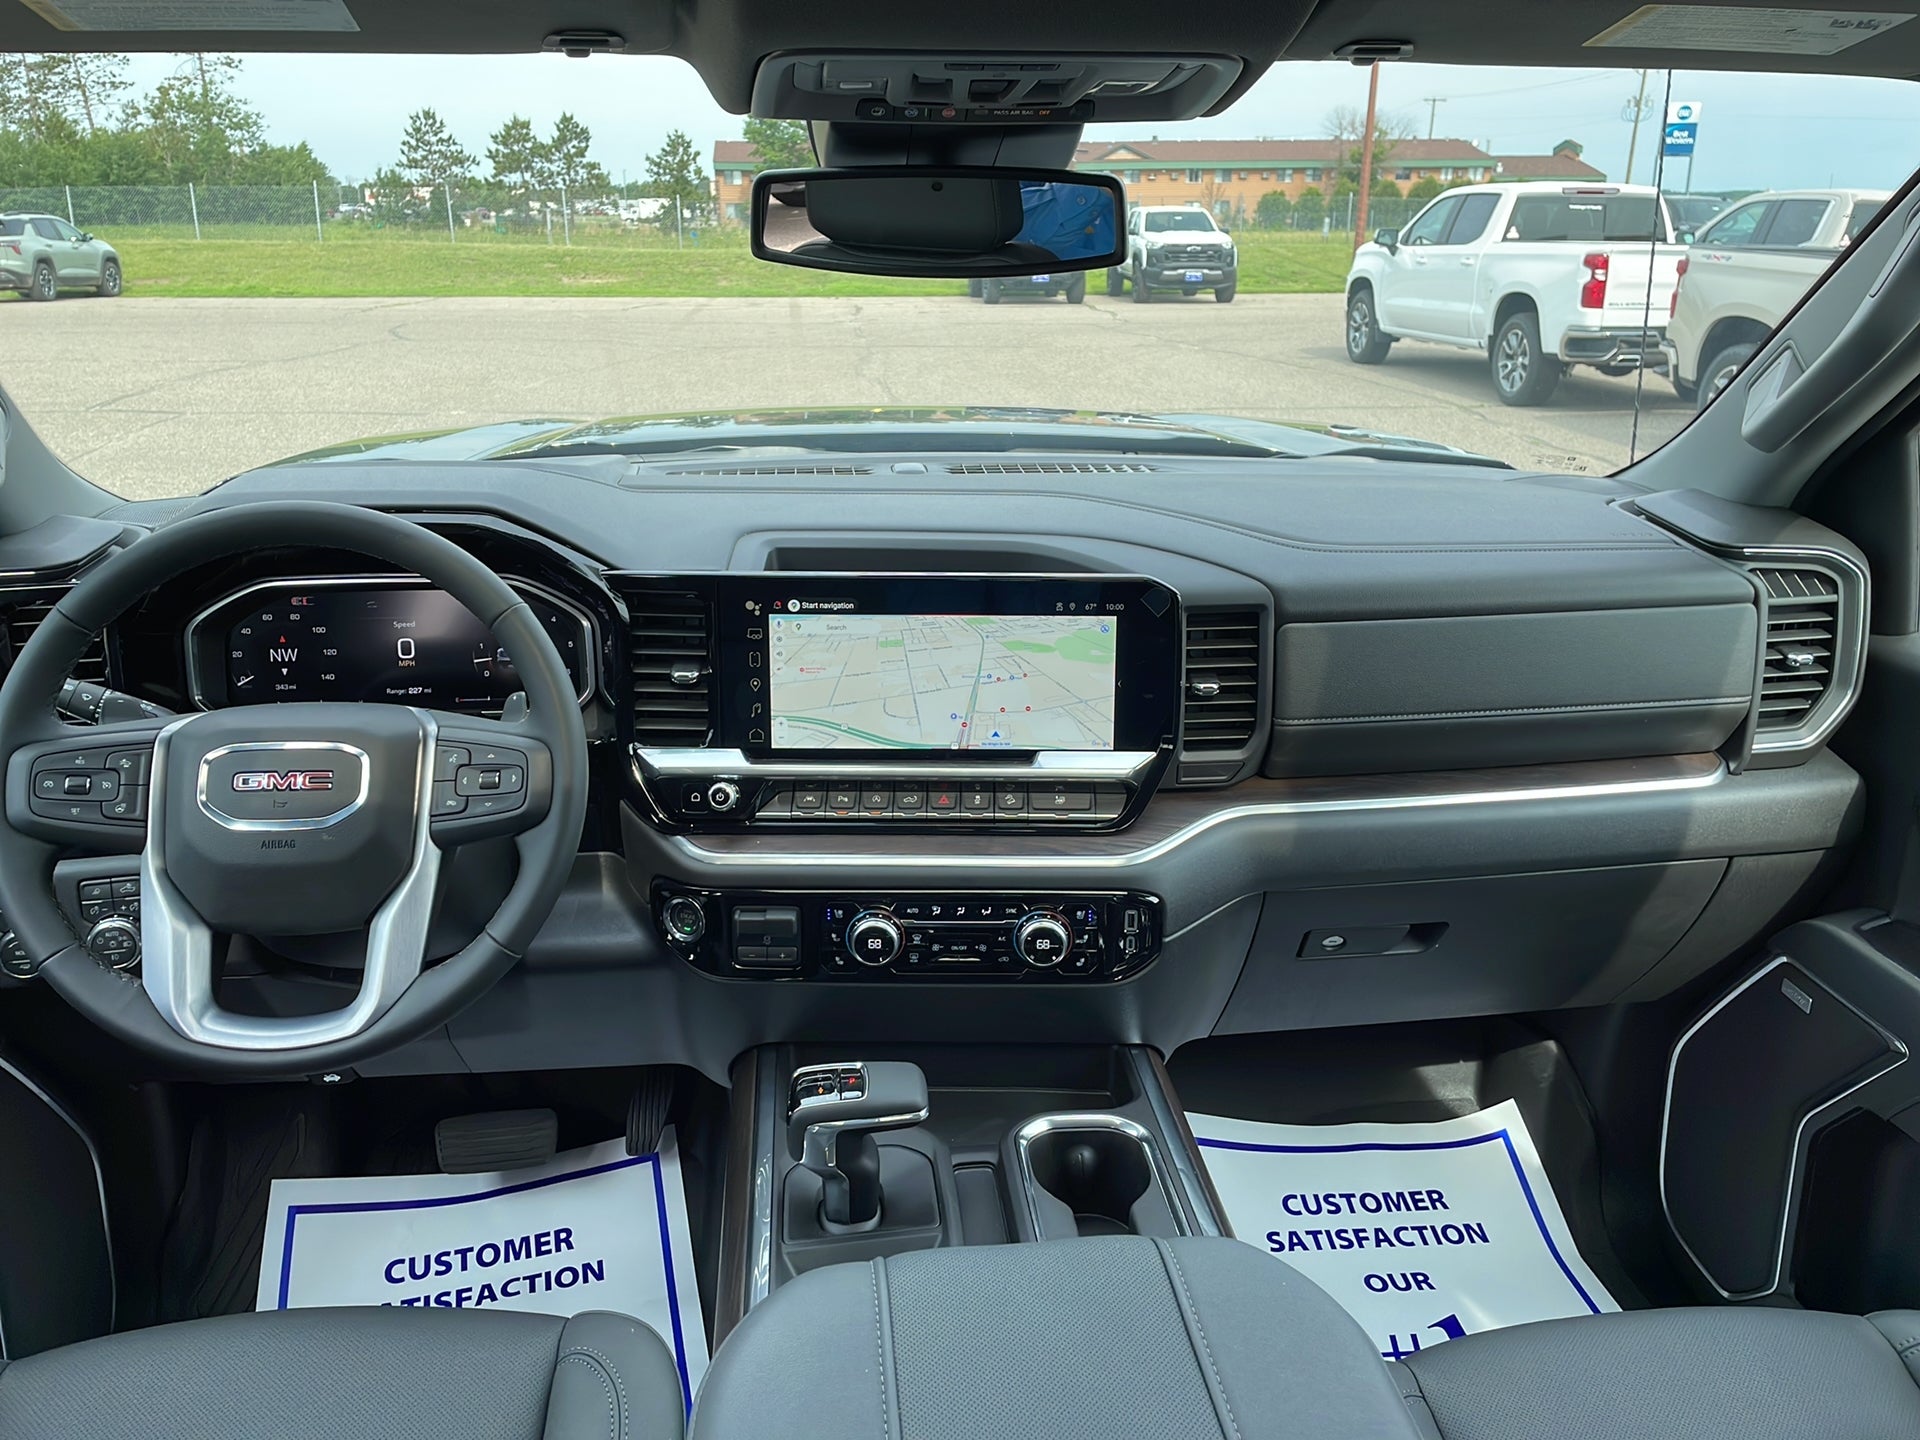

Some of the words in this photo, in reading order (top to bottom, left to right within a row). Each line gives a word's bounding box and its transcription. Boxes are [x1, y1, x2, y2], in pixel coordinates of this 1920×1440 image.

[819, 602, 854, 611] navigation
[312, 626, 326, 634] 100
[392, 621, 416, 629] Speed
[232, 650, 243, 658] 20
[397, 637, 416, 659] 0
[269, 648, 298, 662] NW
[386, 688, 408, 696] Range:
[408, 687, 423, 695] 227
[233, 771, 333, 791] GMC
[261, 840, 296, 850] AIRBAG
[867, 939, 882, 949] 68
[1036, 939, 1050, 950] 68
[1281, 1189, 1451, 1216] CUSTOMER
[1265, 1222, 1490, 1253] SATISFACTION
[383, 1226, 575, 1285] CUSTOMER
[381, 1258, 606, 1308] ISFACTION
[1363, 1272, 1436, 1293] OUR
